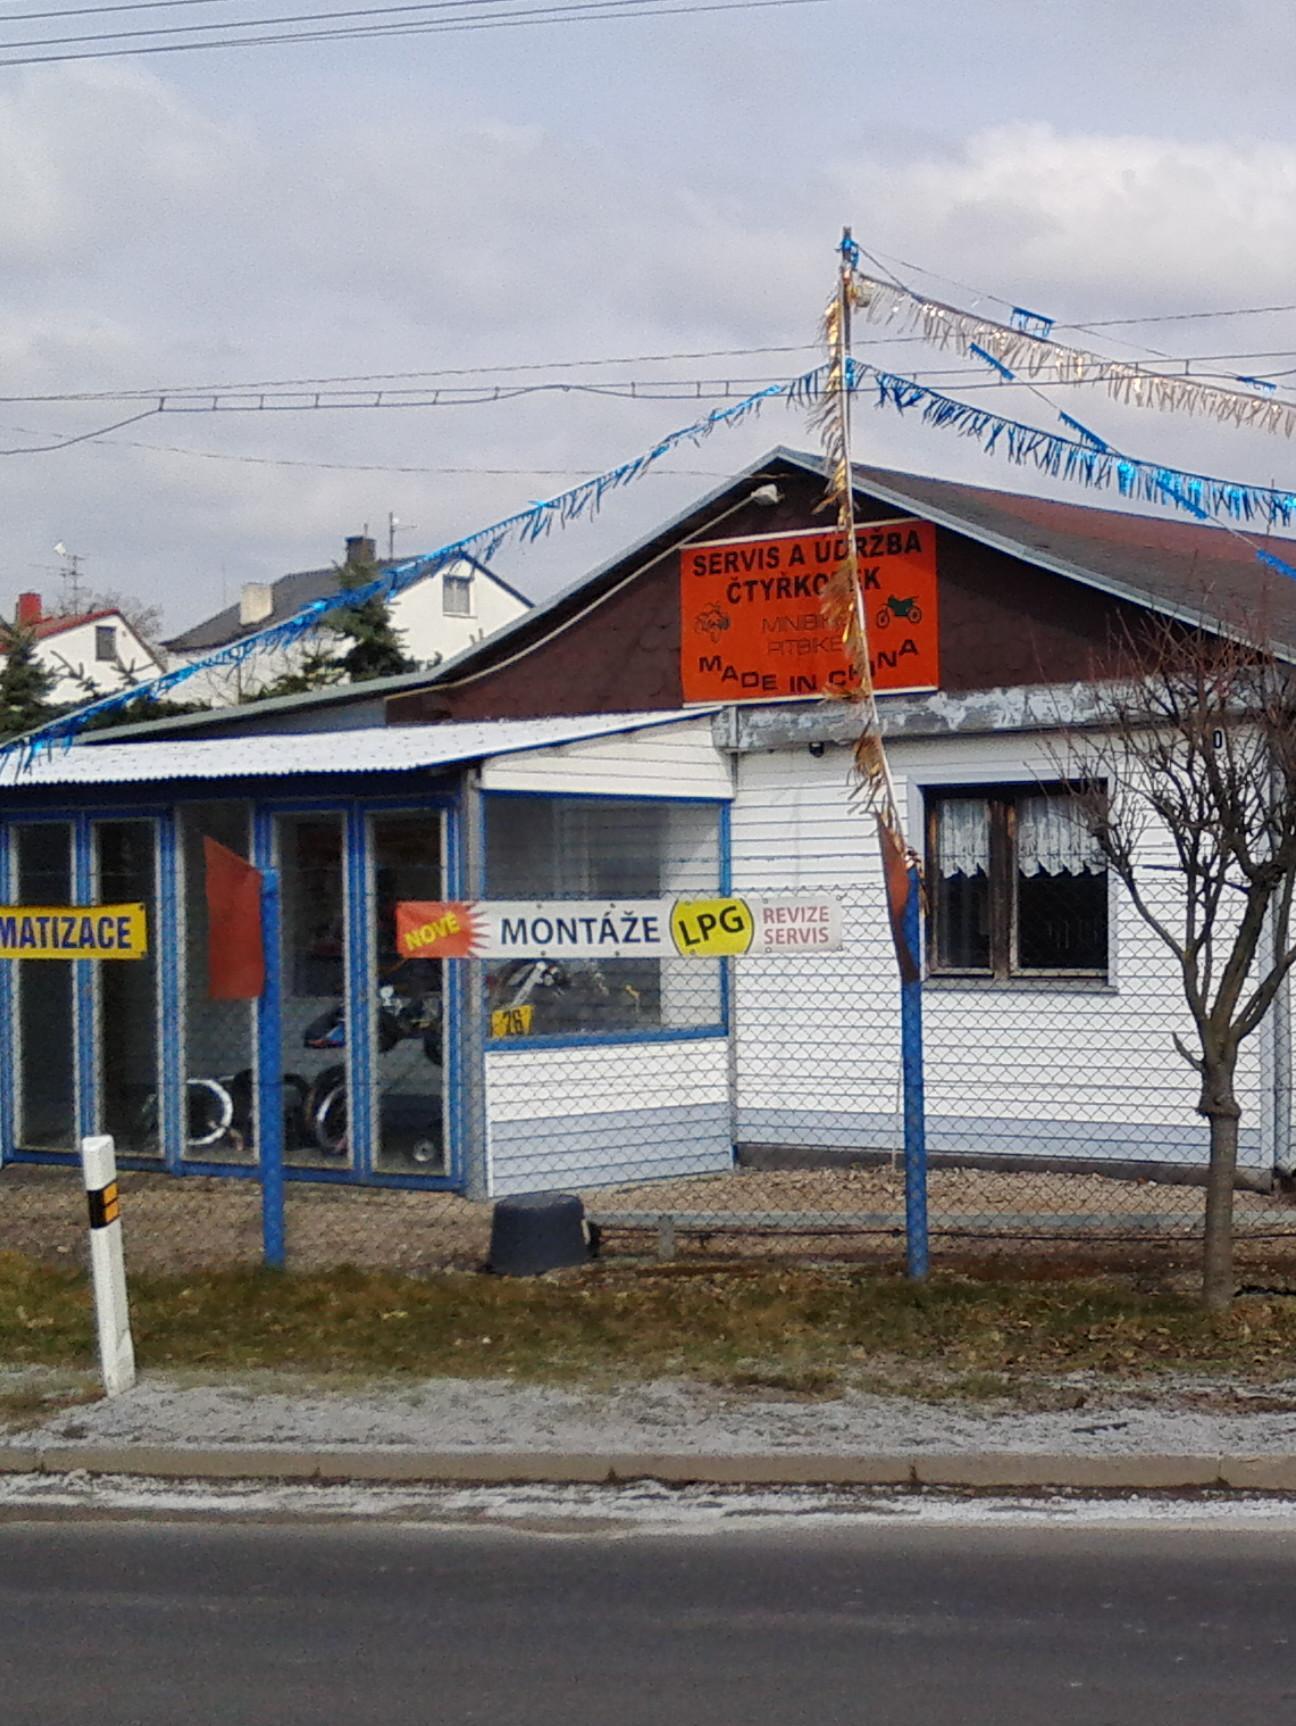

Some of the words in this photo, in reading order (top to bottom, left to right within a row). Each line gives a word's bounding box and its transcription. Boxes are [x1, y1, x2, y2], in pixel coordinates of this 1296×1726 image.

[693, 546, 780, 577] SERVIS
[789, 544, 805, 566] A
[815, 527, 922, 563] ÚDRŽBA
[727, 567, 880, 604] ČTYŘKOEK
[699, 655, 778, 691] MADE
[790, 674, 817, 693] IN
[0, 916, 132, 949] MATIZACE
[501, 910, 661, 945] MONTÁŽE
[678, 905, 745, 947] LPG
[763, 906, 830, 924] REVIZE
[764, 927, 829, 945] SERVIS
